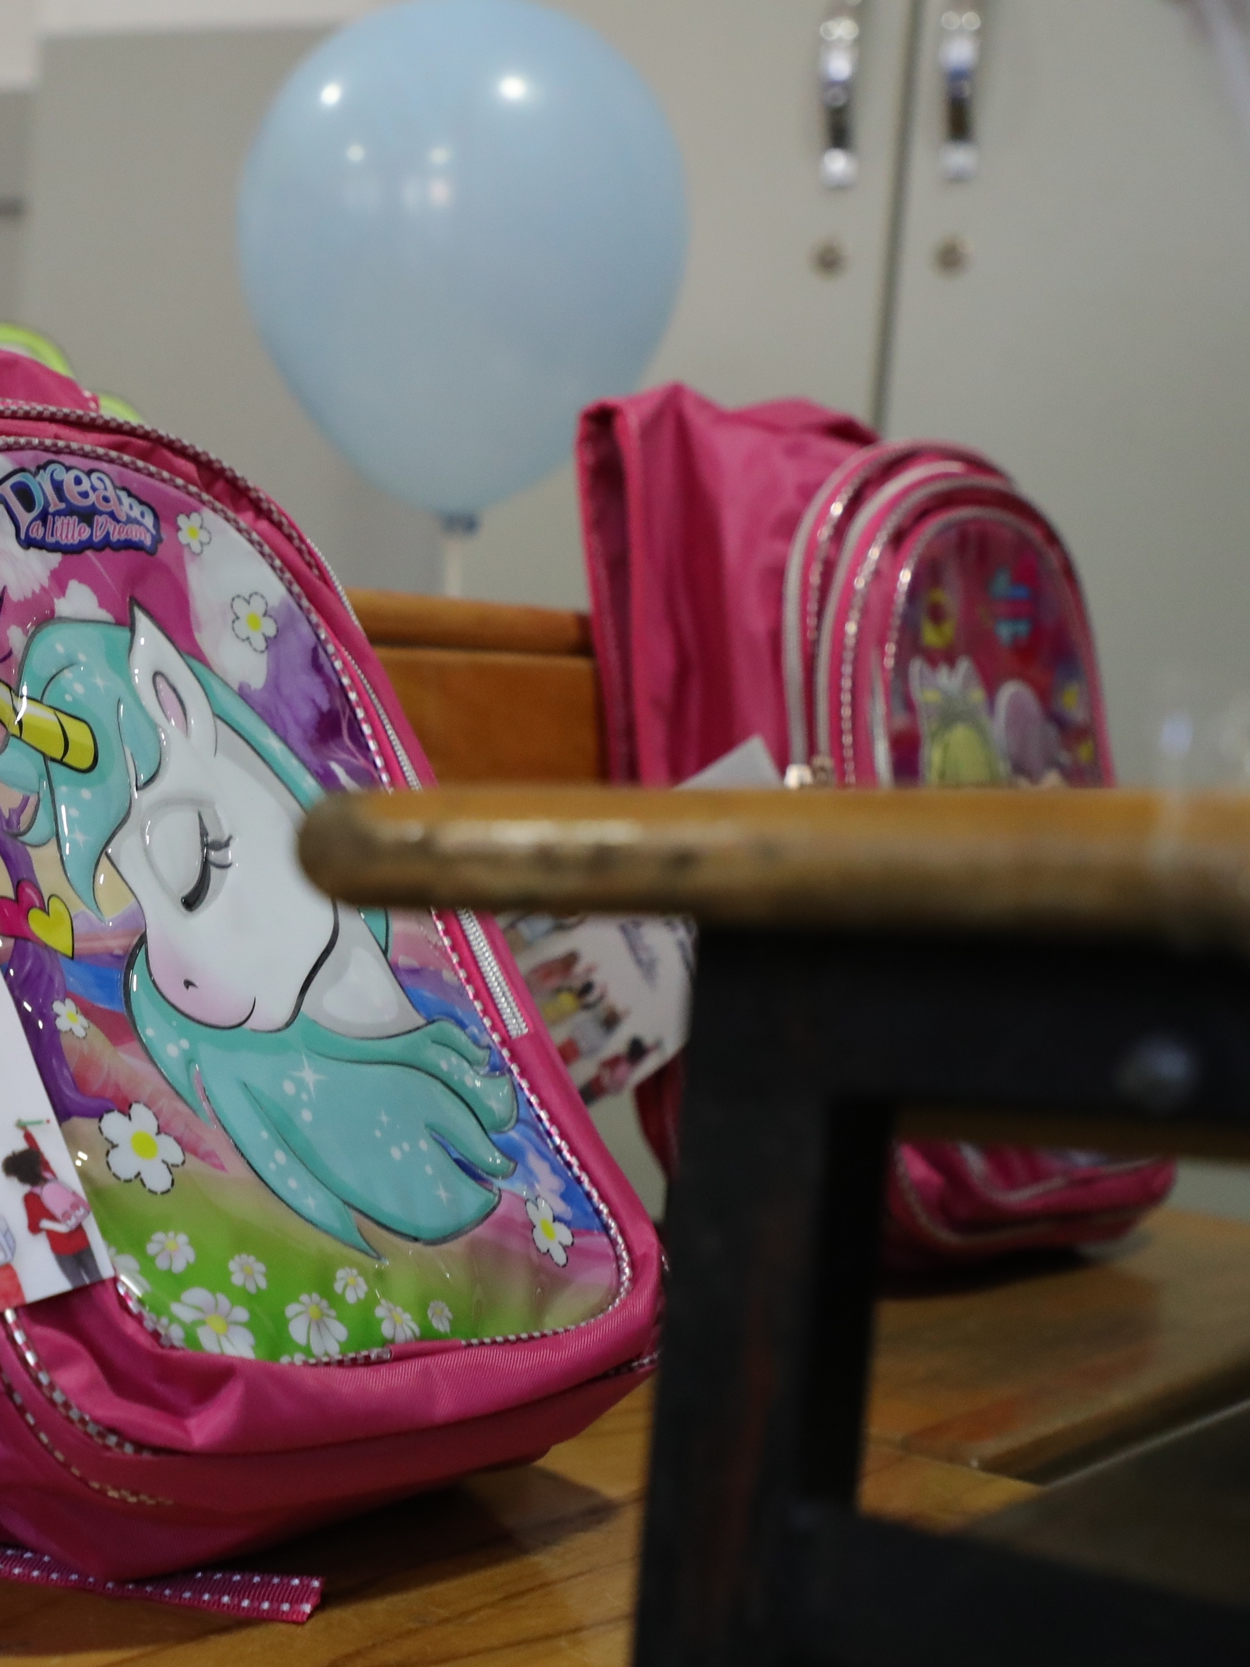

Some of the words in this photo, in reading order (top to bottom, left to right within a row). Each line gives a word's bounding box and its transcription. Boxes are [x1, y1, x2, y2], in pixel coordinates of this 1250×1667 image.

[28, 522, 45, 540] a
[45, 515, 90, 544] Little
[92, 515, 152, 547] Dream
